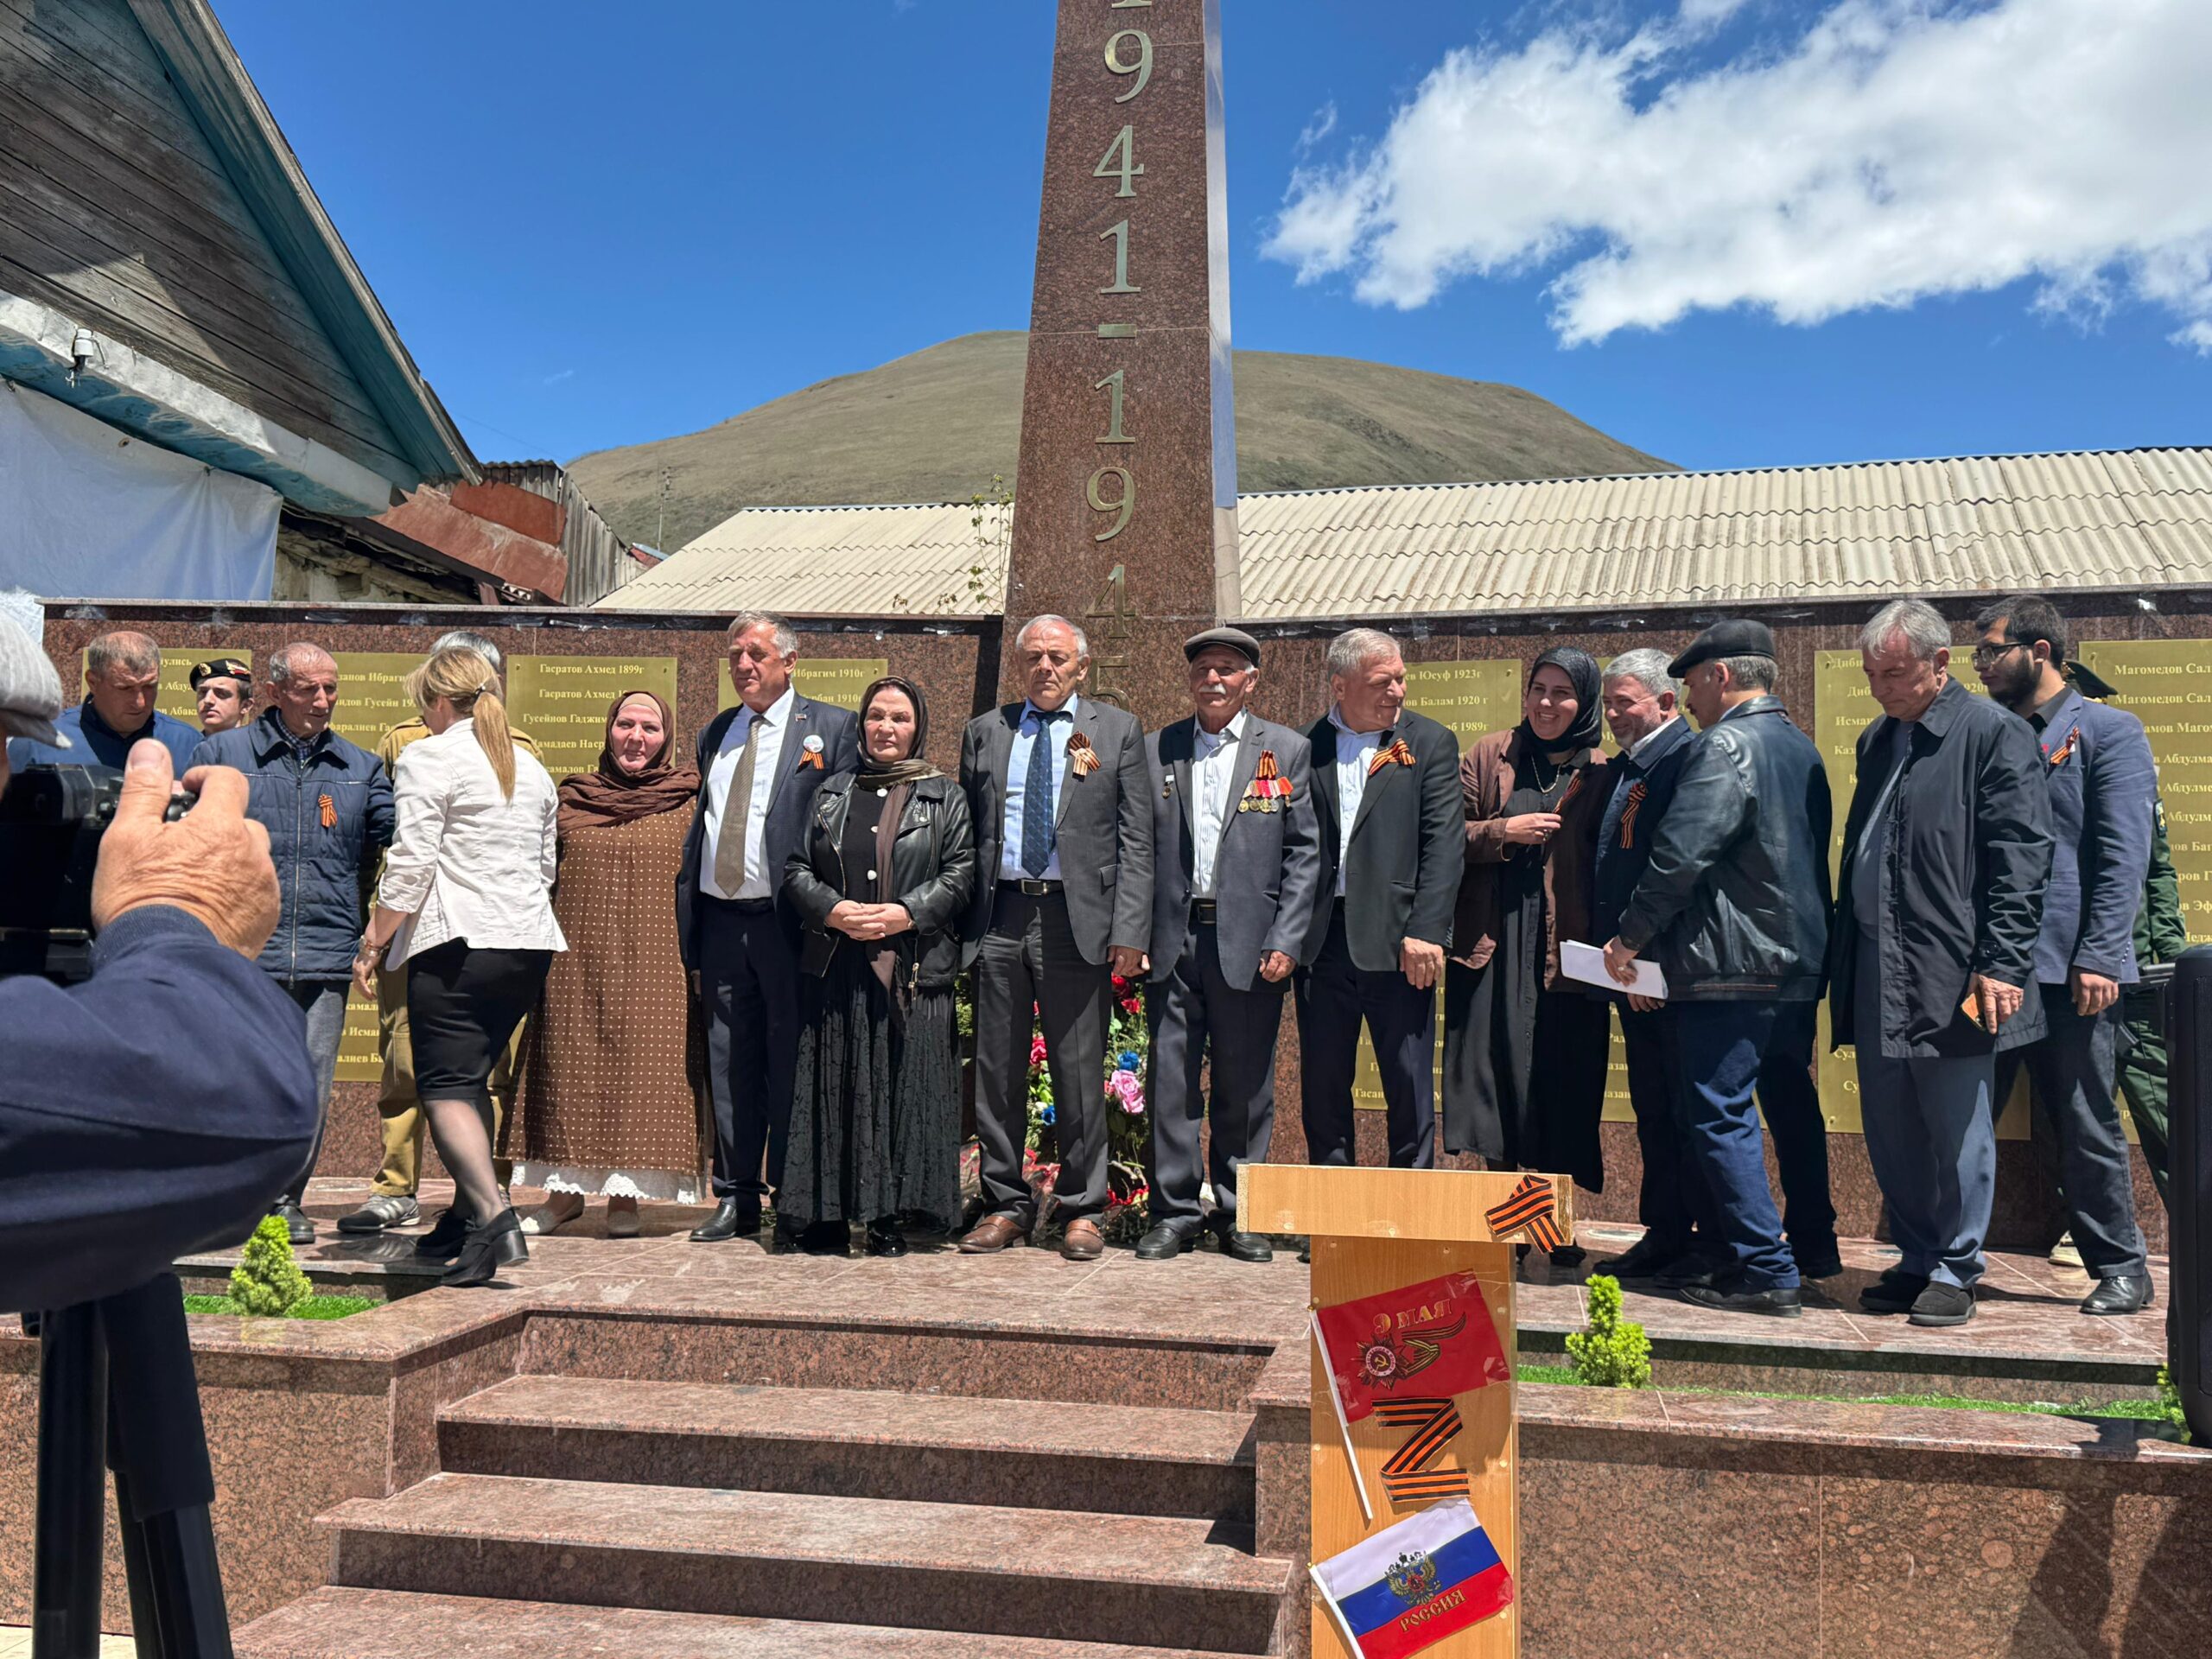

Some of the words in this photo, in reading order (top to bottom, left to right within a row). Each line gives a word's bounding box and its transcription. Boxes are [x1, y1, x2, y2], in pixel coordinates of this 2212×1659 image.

[539, 664, 582, 676] Гасратов
[585, 664, 616, 675] Ахмед
[619, 664, 645, 675] 1899г
[793, 669, 836, 680] Ибрагим
[2114, 664, 2183, 675] Магомедов
[2186, 663, 2212, 674] Сал
[368, 672, 406, 684] Ибраги
[1419, 670, 1452, 682] Юсуф
[1454, 670, 1482, 679] 1923г
[539, 689, 582, 701] Гасратов
[584, 689, 615, 700] Ахмед
[2114, 694, 2183, 705] Магомедов
[2186, 693, 2212, 703] Сал
[364, 697, 399, 709] Гусейн
[1421, 696, 1454, 707] Балам
[1458, 696, 1480, 706] 1920
[524, 713, 568, 724] Гусейнов
[570, 714, 607, 724] Гаджим
[1460, 721, 1489, 732] 1989г
[2144, 725, 2173, 734] амов
[580, 739, 605, 750] Наср
[2164, 753, 2212, 766] Абдулма
[2164, 782, 2212, 795] Абдулме
[2167, 810, 2212, 824] Абдулм
[336, 1054, 369, 1064] алиев
[1373, 1313, 1391, 1334] 9
[1396, 1299, 1452, 1329] МАЯ
[1400, 1589, 1466, 1632] РОССИЯ
